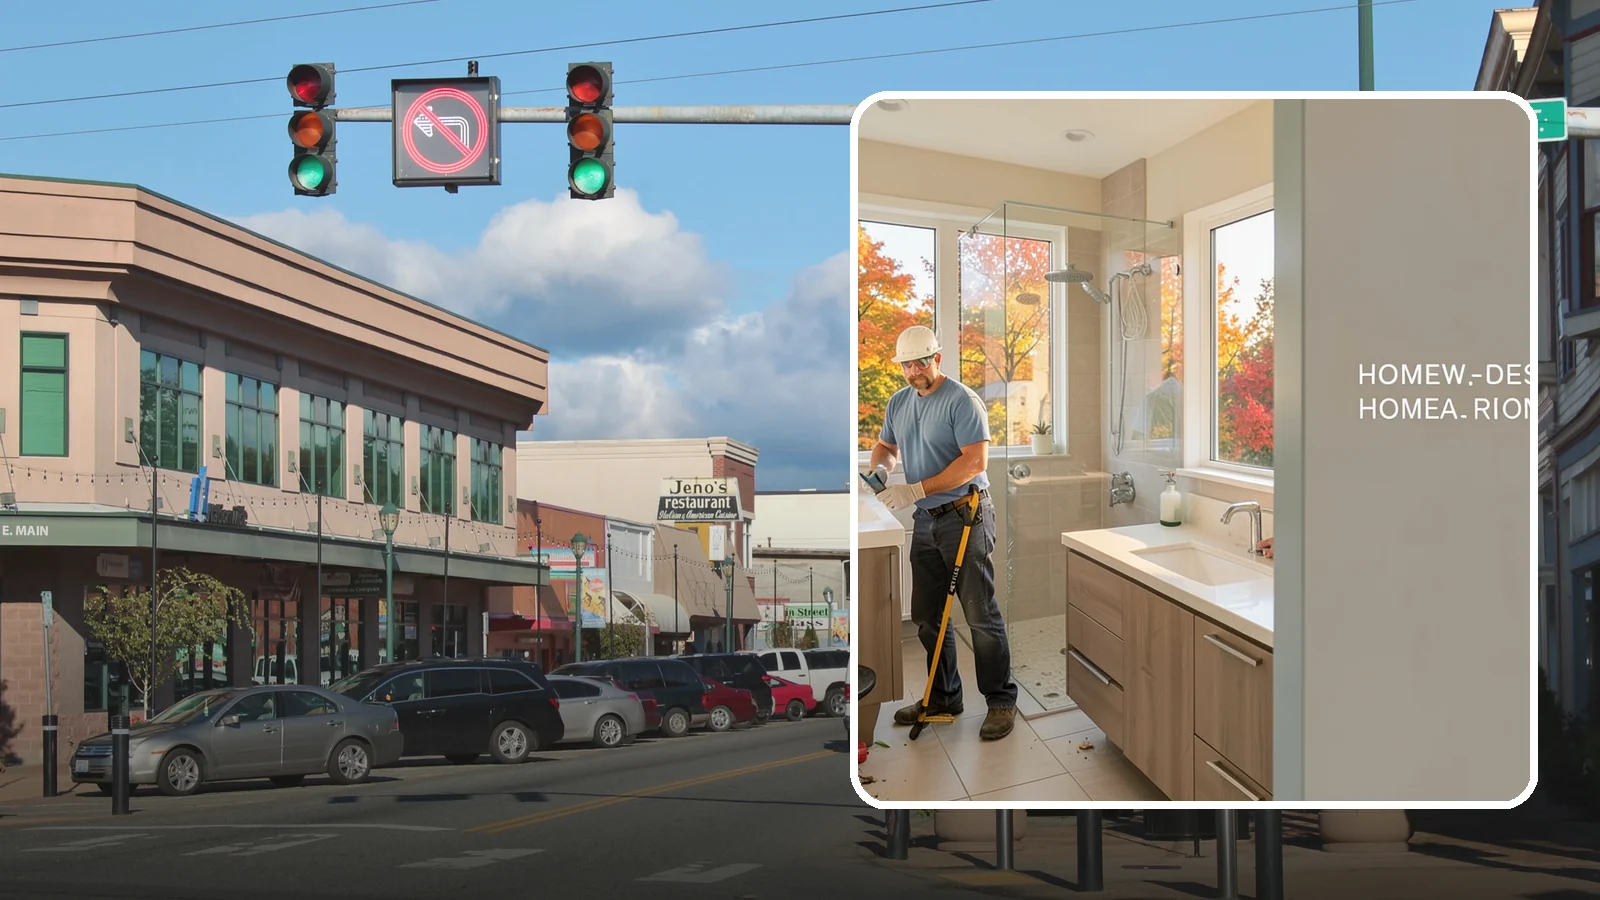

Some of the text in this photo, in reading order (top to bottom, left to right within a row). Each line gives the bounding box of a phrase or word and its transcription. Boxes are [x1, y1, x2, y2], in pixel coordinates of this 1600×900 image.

[670, 480, 728, 494] Jeno's
[665, 496, 731, 509] restaurant
[686, 509, 714, 519] American
[715, 509, 738, 519] Cuisine
[2, 524, 49, 537] E. MAIN
[797, 607, 828, 617] Street
